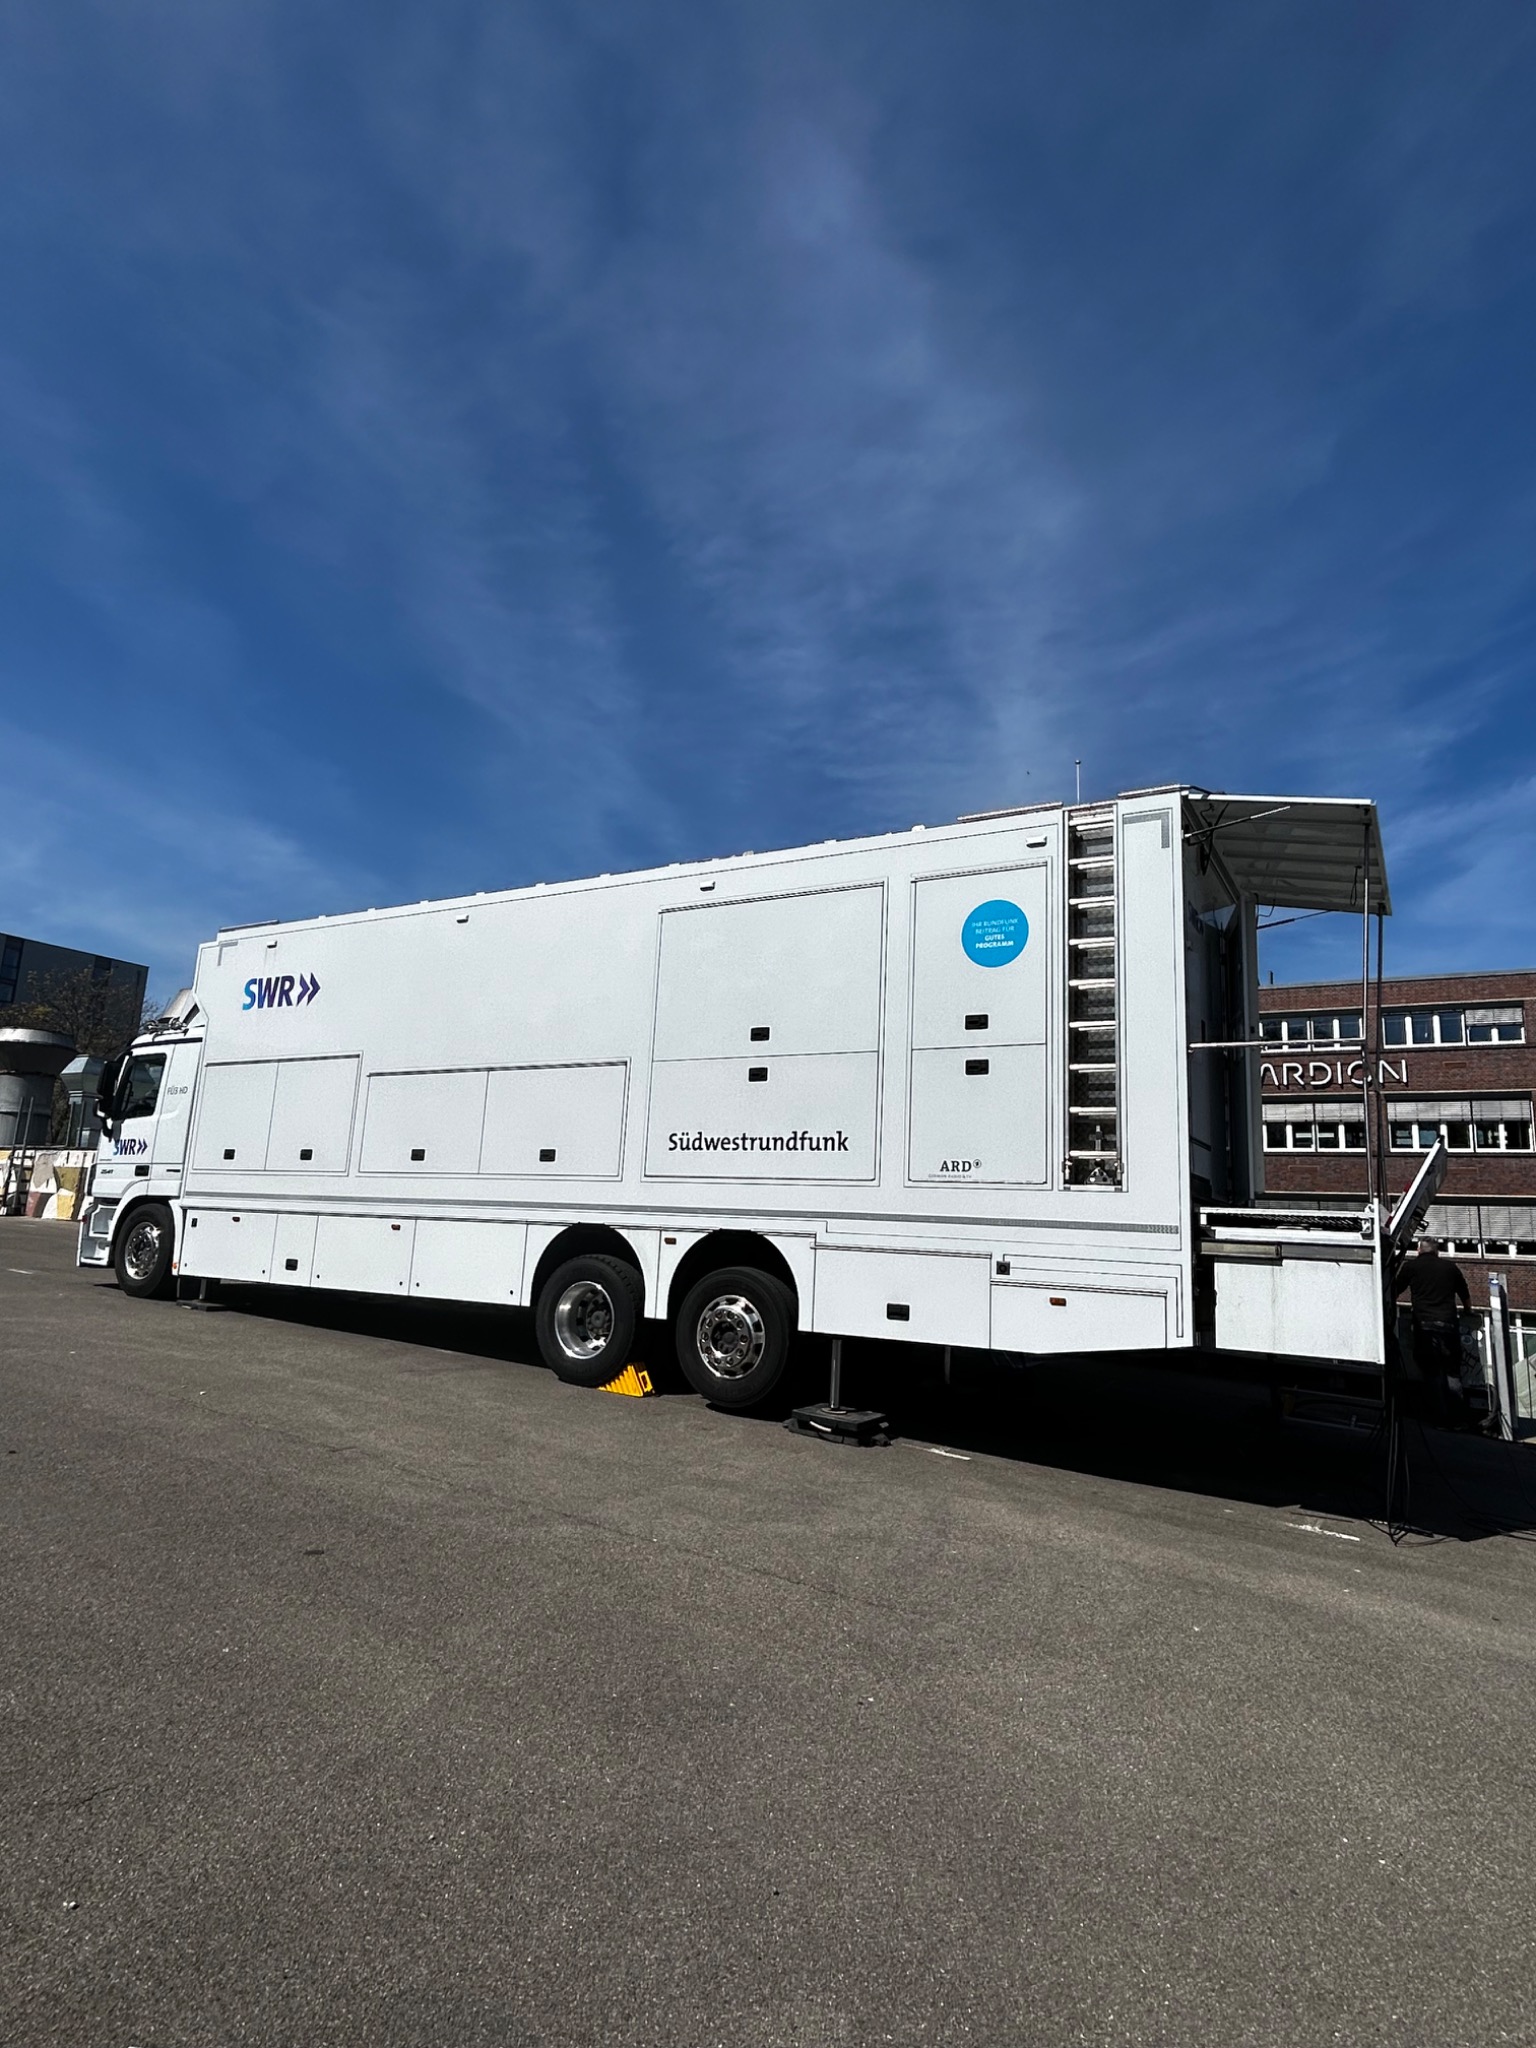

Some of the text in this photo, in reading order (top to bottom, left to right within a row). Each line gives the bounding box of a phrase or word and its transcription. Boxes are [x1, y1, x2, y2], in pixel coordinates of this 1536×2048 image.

[975, 940, 1014, 949] PROGRAMM
[984, 933, 1005, 942] GUTES
[242, 975, 293, 1010] SWR
[113, 1139, 137, 1155] SWR
[668, 1131, 849, 1151] Südwestrundfunk
[940, 1160, 972, 1172] ARD
